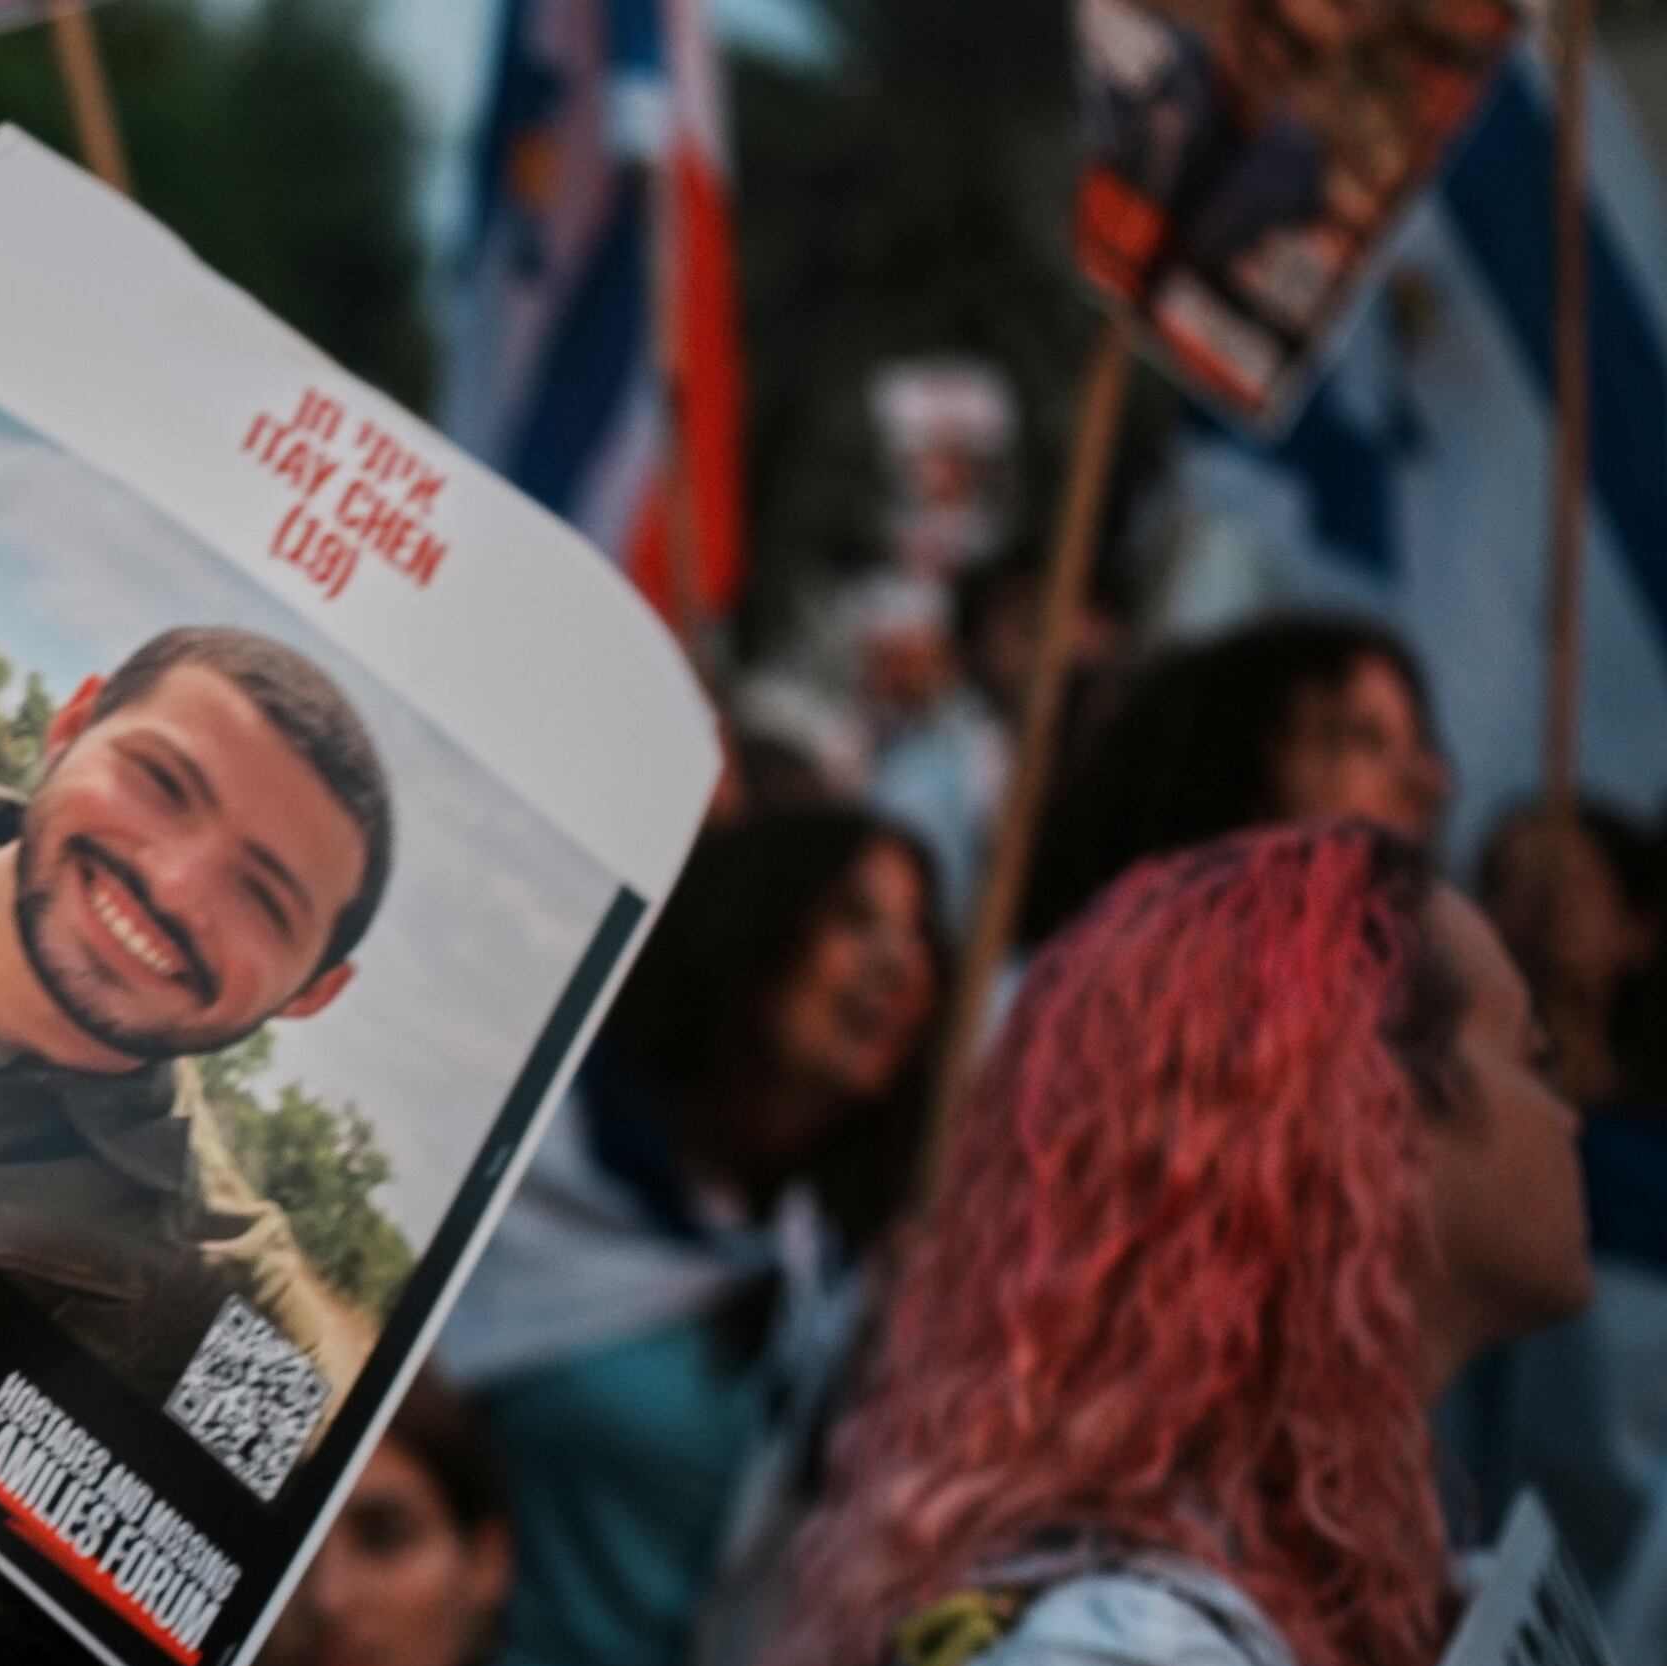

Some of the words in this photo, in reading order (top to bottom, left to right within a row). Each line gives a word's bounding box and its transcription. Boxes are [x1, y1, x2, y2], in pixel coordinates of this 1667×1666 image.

[242, 411, 340, 498] ITAY
[335, 479, 449, 587] CHEN
[95, 1463, 154, 1525] AND
[141, 1498, 243, 1601] MISSING
[96, 1524, 223, 1653] FORUM
